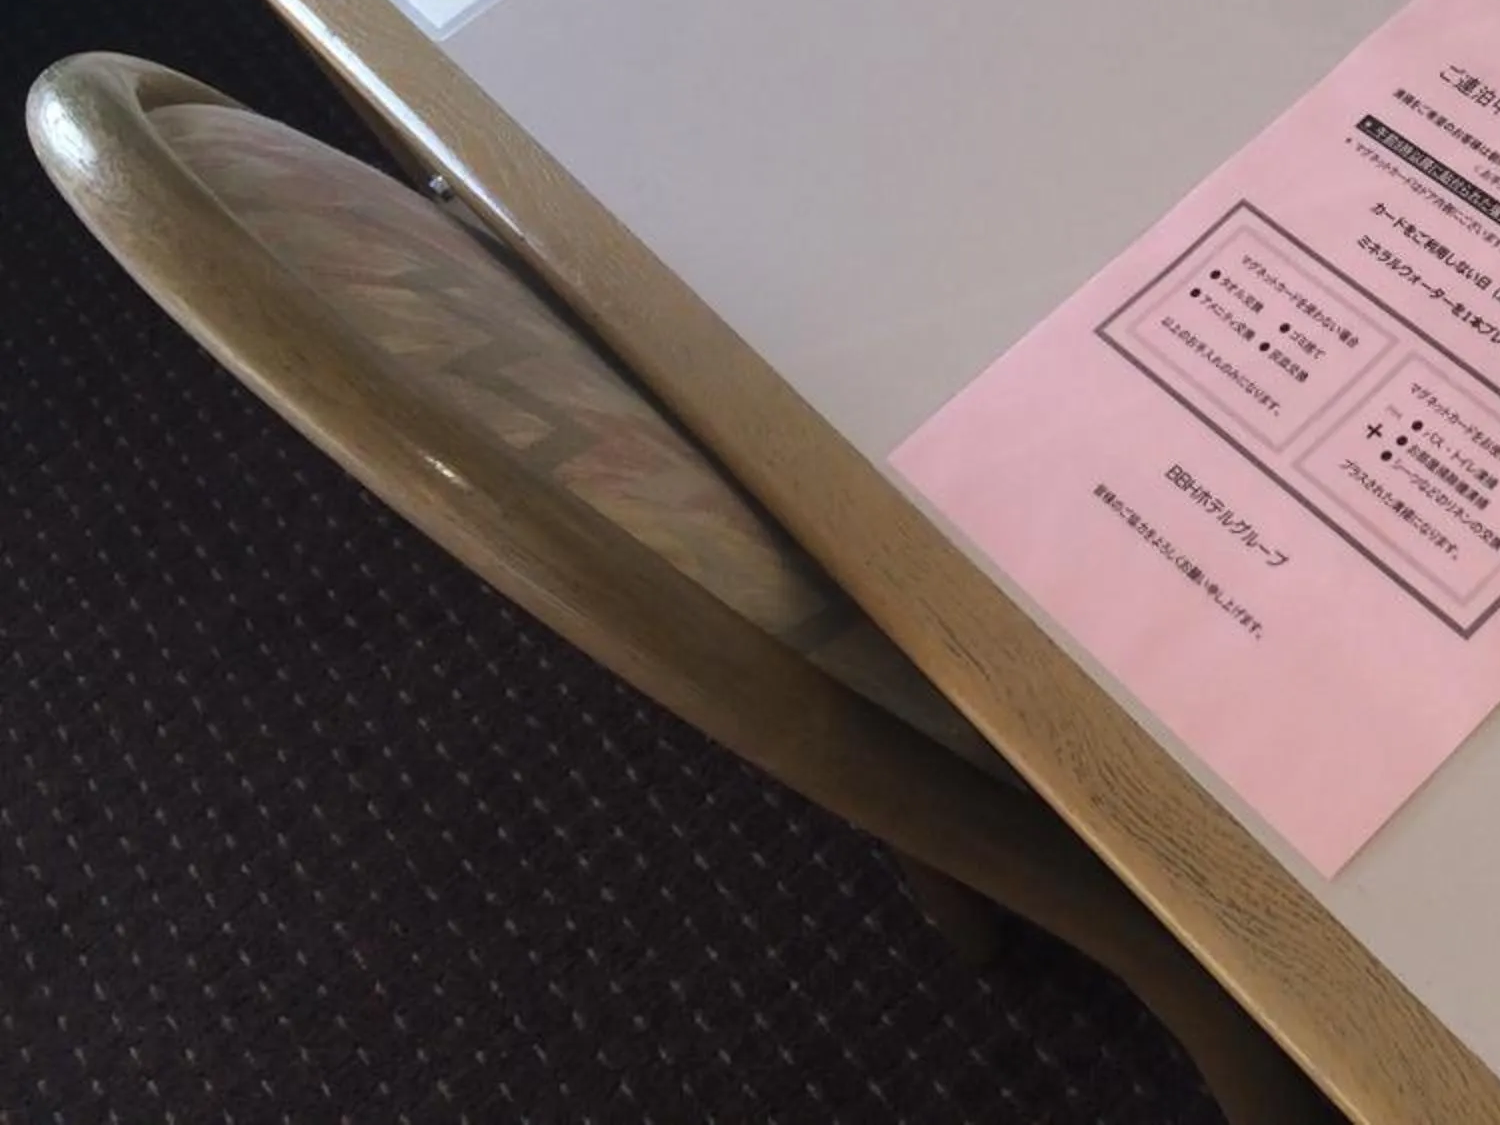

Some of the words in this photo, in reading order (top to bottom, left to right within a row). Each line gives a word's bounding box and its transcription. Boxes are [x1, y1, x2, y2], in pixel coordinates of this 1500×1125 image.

[1163, 462, 1290, 573] BBHホテルグループ
